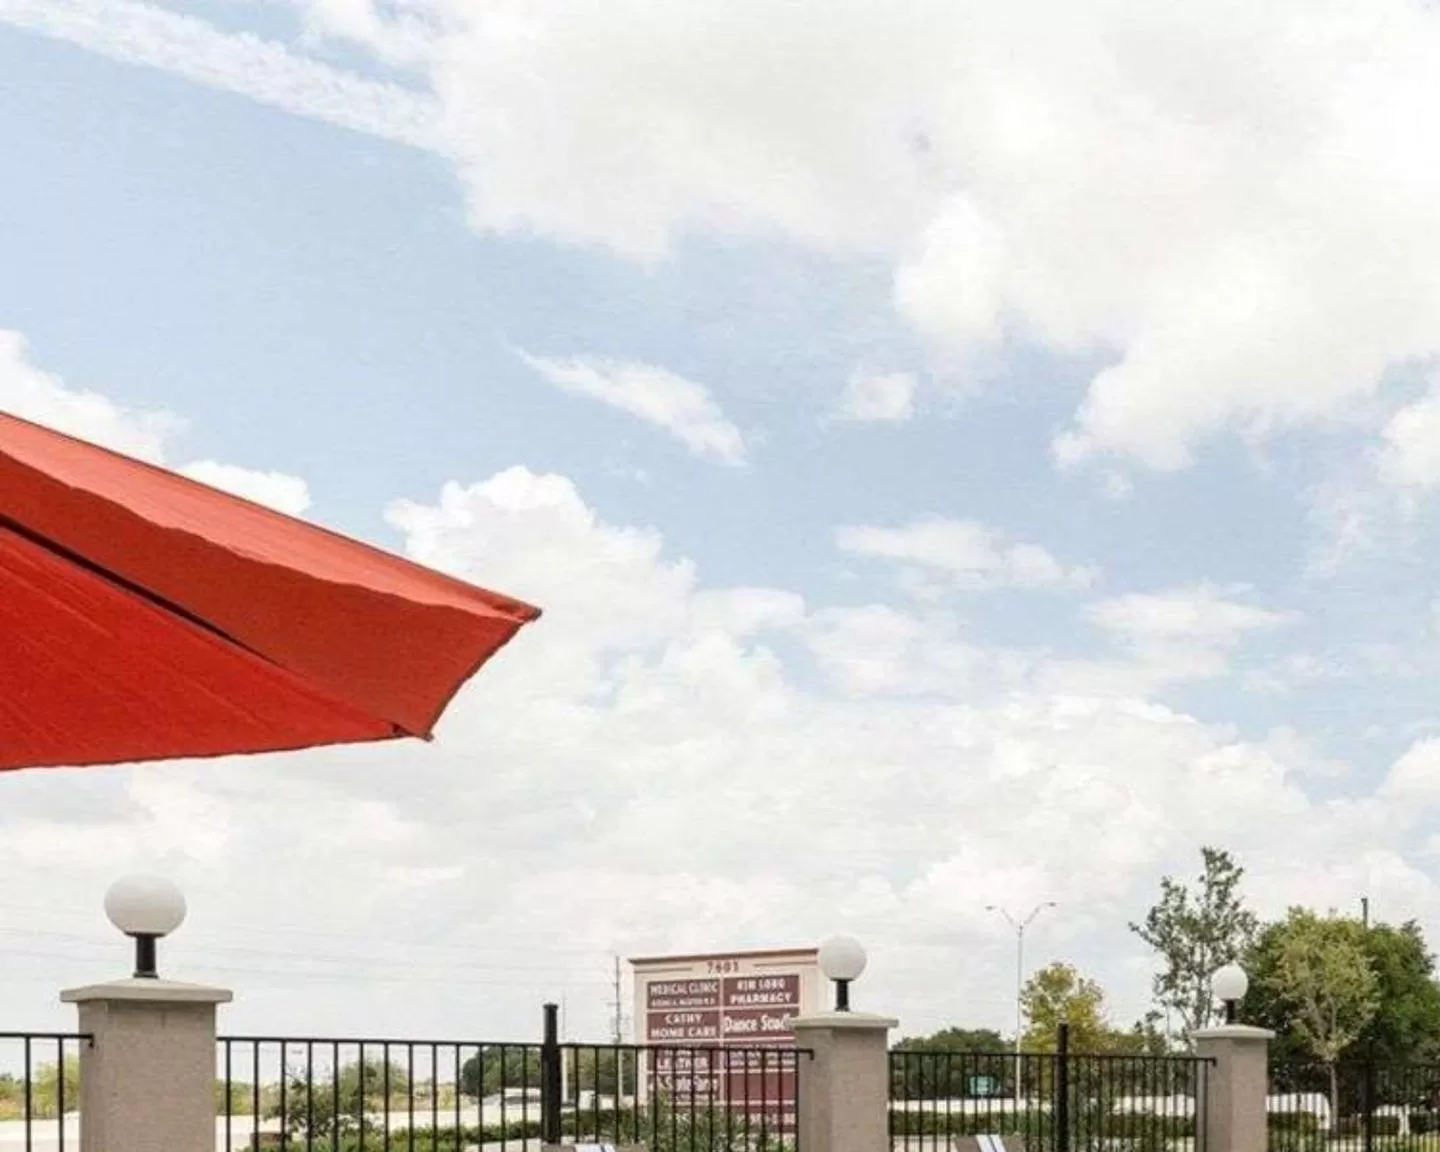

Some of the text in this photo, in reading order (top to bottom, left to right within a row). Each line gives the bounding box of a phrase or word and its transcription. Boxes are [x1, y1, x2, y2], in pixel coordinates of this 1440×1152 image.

[689, 982, 718, 994] CLINIC
[730, 991, 793, 1004] PHARMACY
[650, 1025, 717, 1038] HOME CARE
